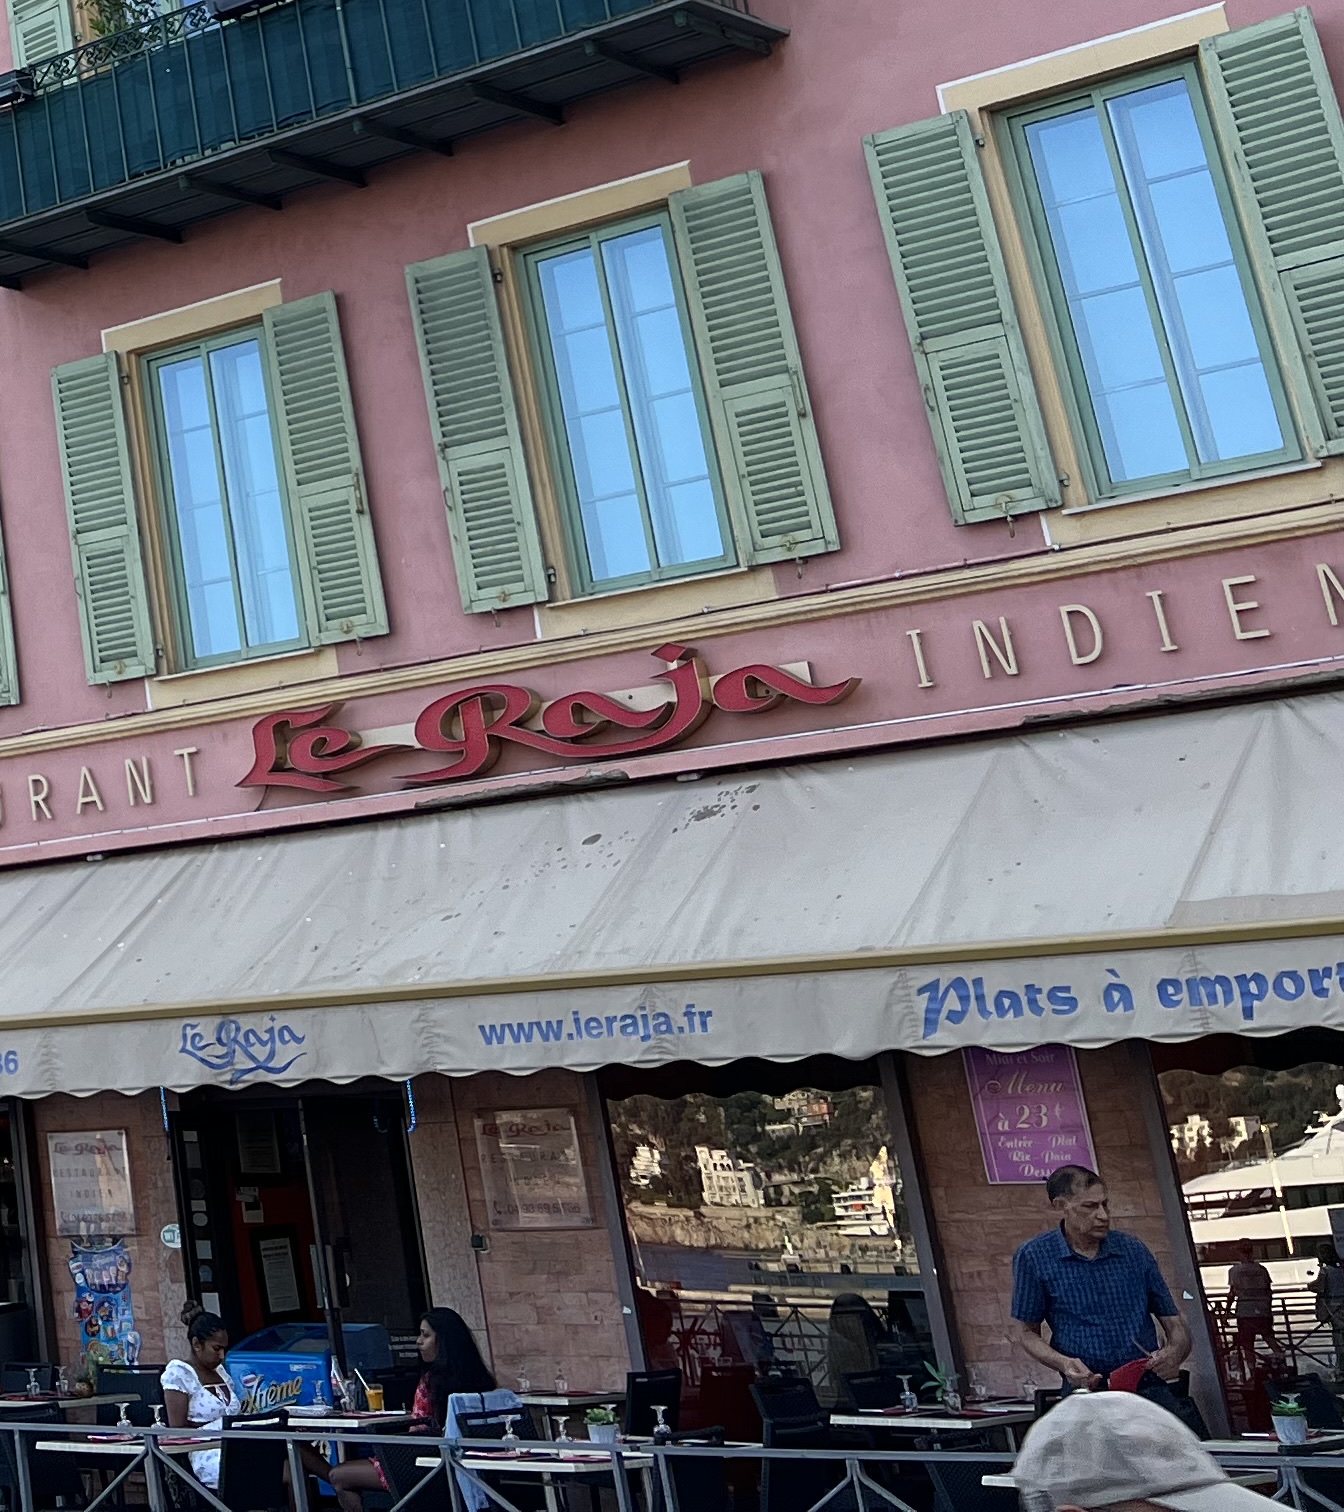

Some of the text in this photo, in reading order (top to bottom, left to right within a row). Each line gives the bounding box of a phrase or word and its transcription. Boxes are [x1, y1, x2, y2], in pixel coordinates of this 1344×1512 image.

[906, 563, 1344, 689] INDIEN
[233, 642, 862, 792] Le Raja
[916, 975, 1079, 1040] Plats
[1103, 968, 1134, 1013] à
[179, 1014, 307, 1085] Le Raja
[1030, 1052, 1056, 1065] Soir
[1007, 1071, 1063, 1095] Menu
[998, 1113, 1010, 1131] à
[1016, 1103, 1049, 1129] 23
[998, 1135, 1077, 1148] Entrée Plat
[1019, 1165, 1055, 1177] Dess
